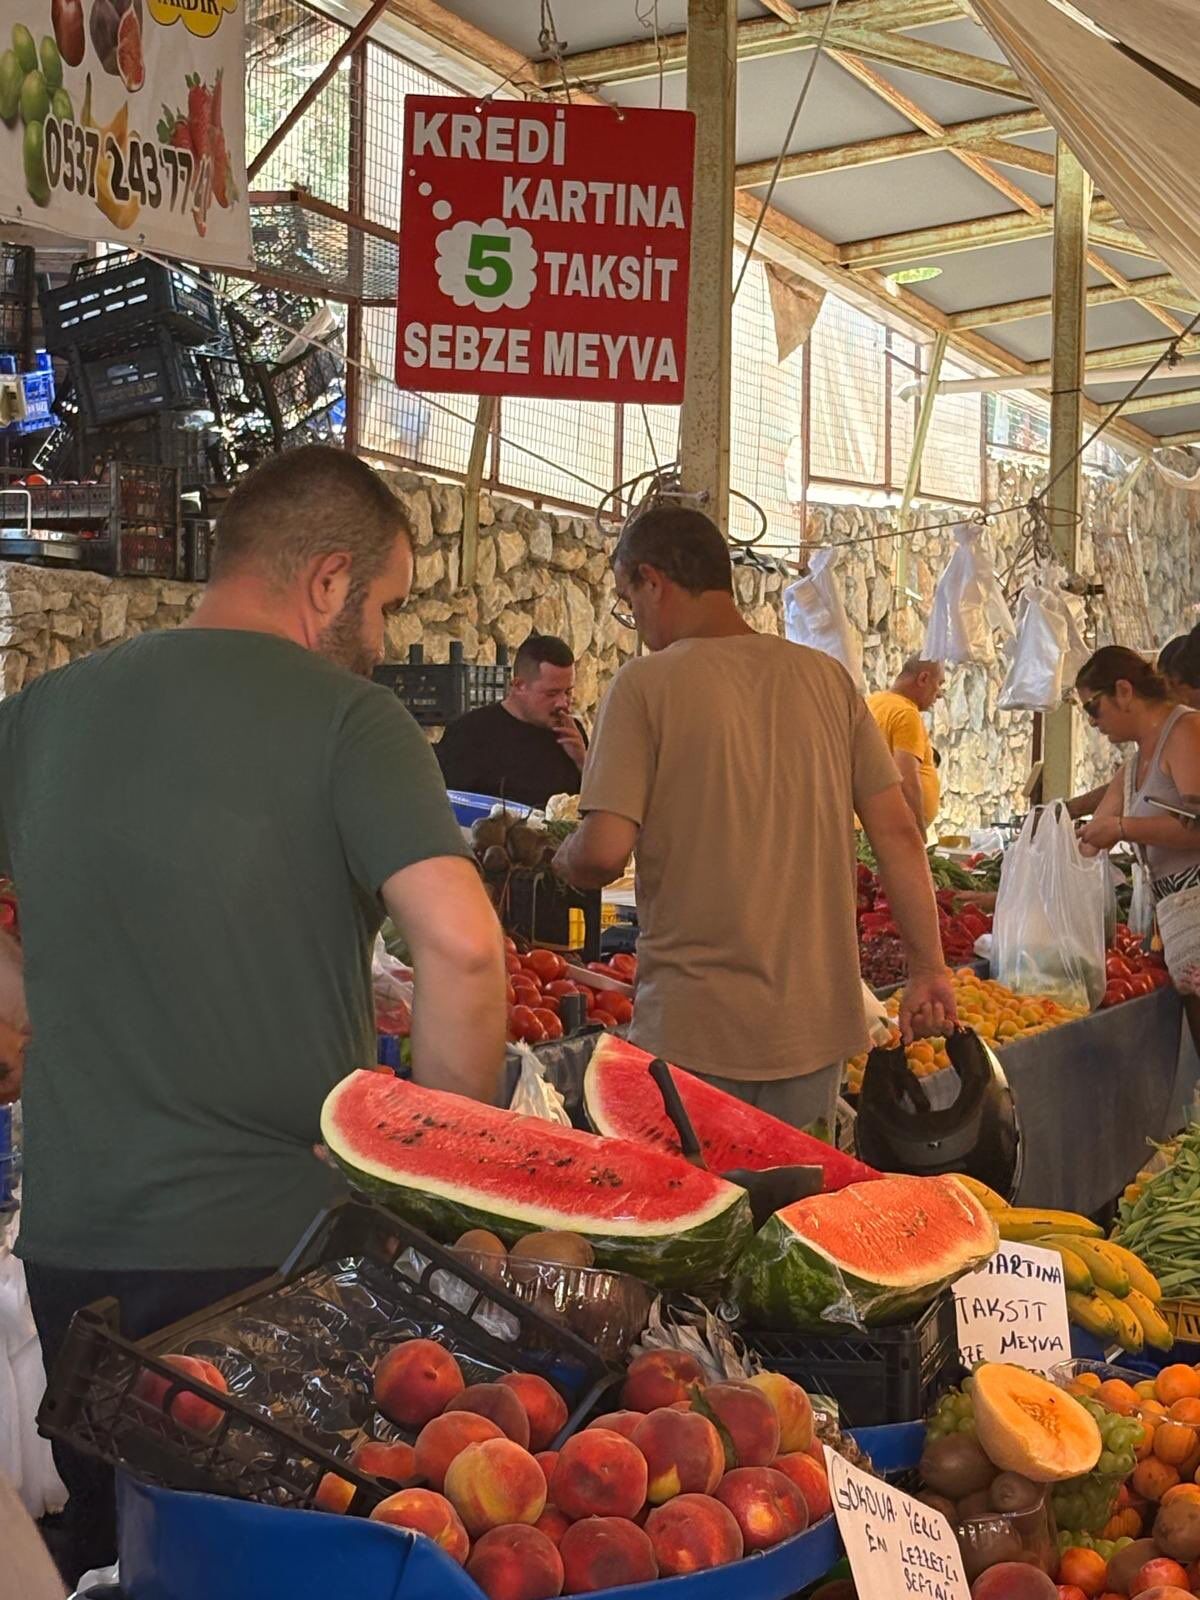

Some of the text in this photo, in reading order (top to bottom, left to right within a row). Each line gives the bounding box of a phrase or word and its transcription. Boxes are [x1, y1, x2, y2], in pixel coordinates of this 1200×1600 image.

[44, 116, 100, 199] 0537
[412, 109, 566, 166] KREDİ
[502, 176, 685, 229] KARTINA
[464, 233, 678, 302] 5 TAKSİT
[403, 321, 679, 383] SEBZE MEYVA
[999, 1330, 1064, 1355] MEYVA
[865, 1522, 888, 1553] EN
